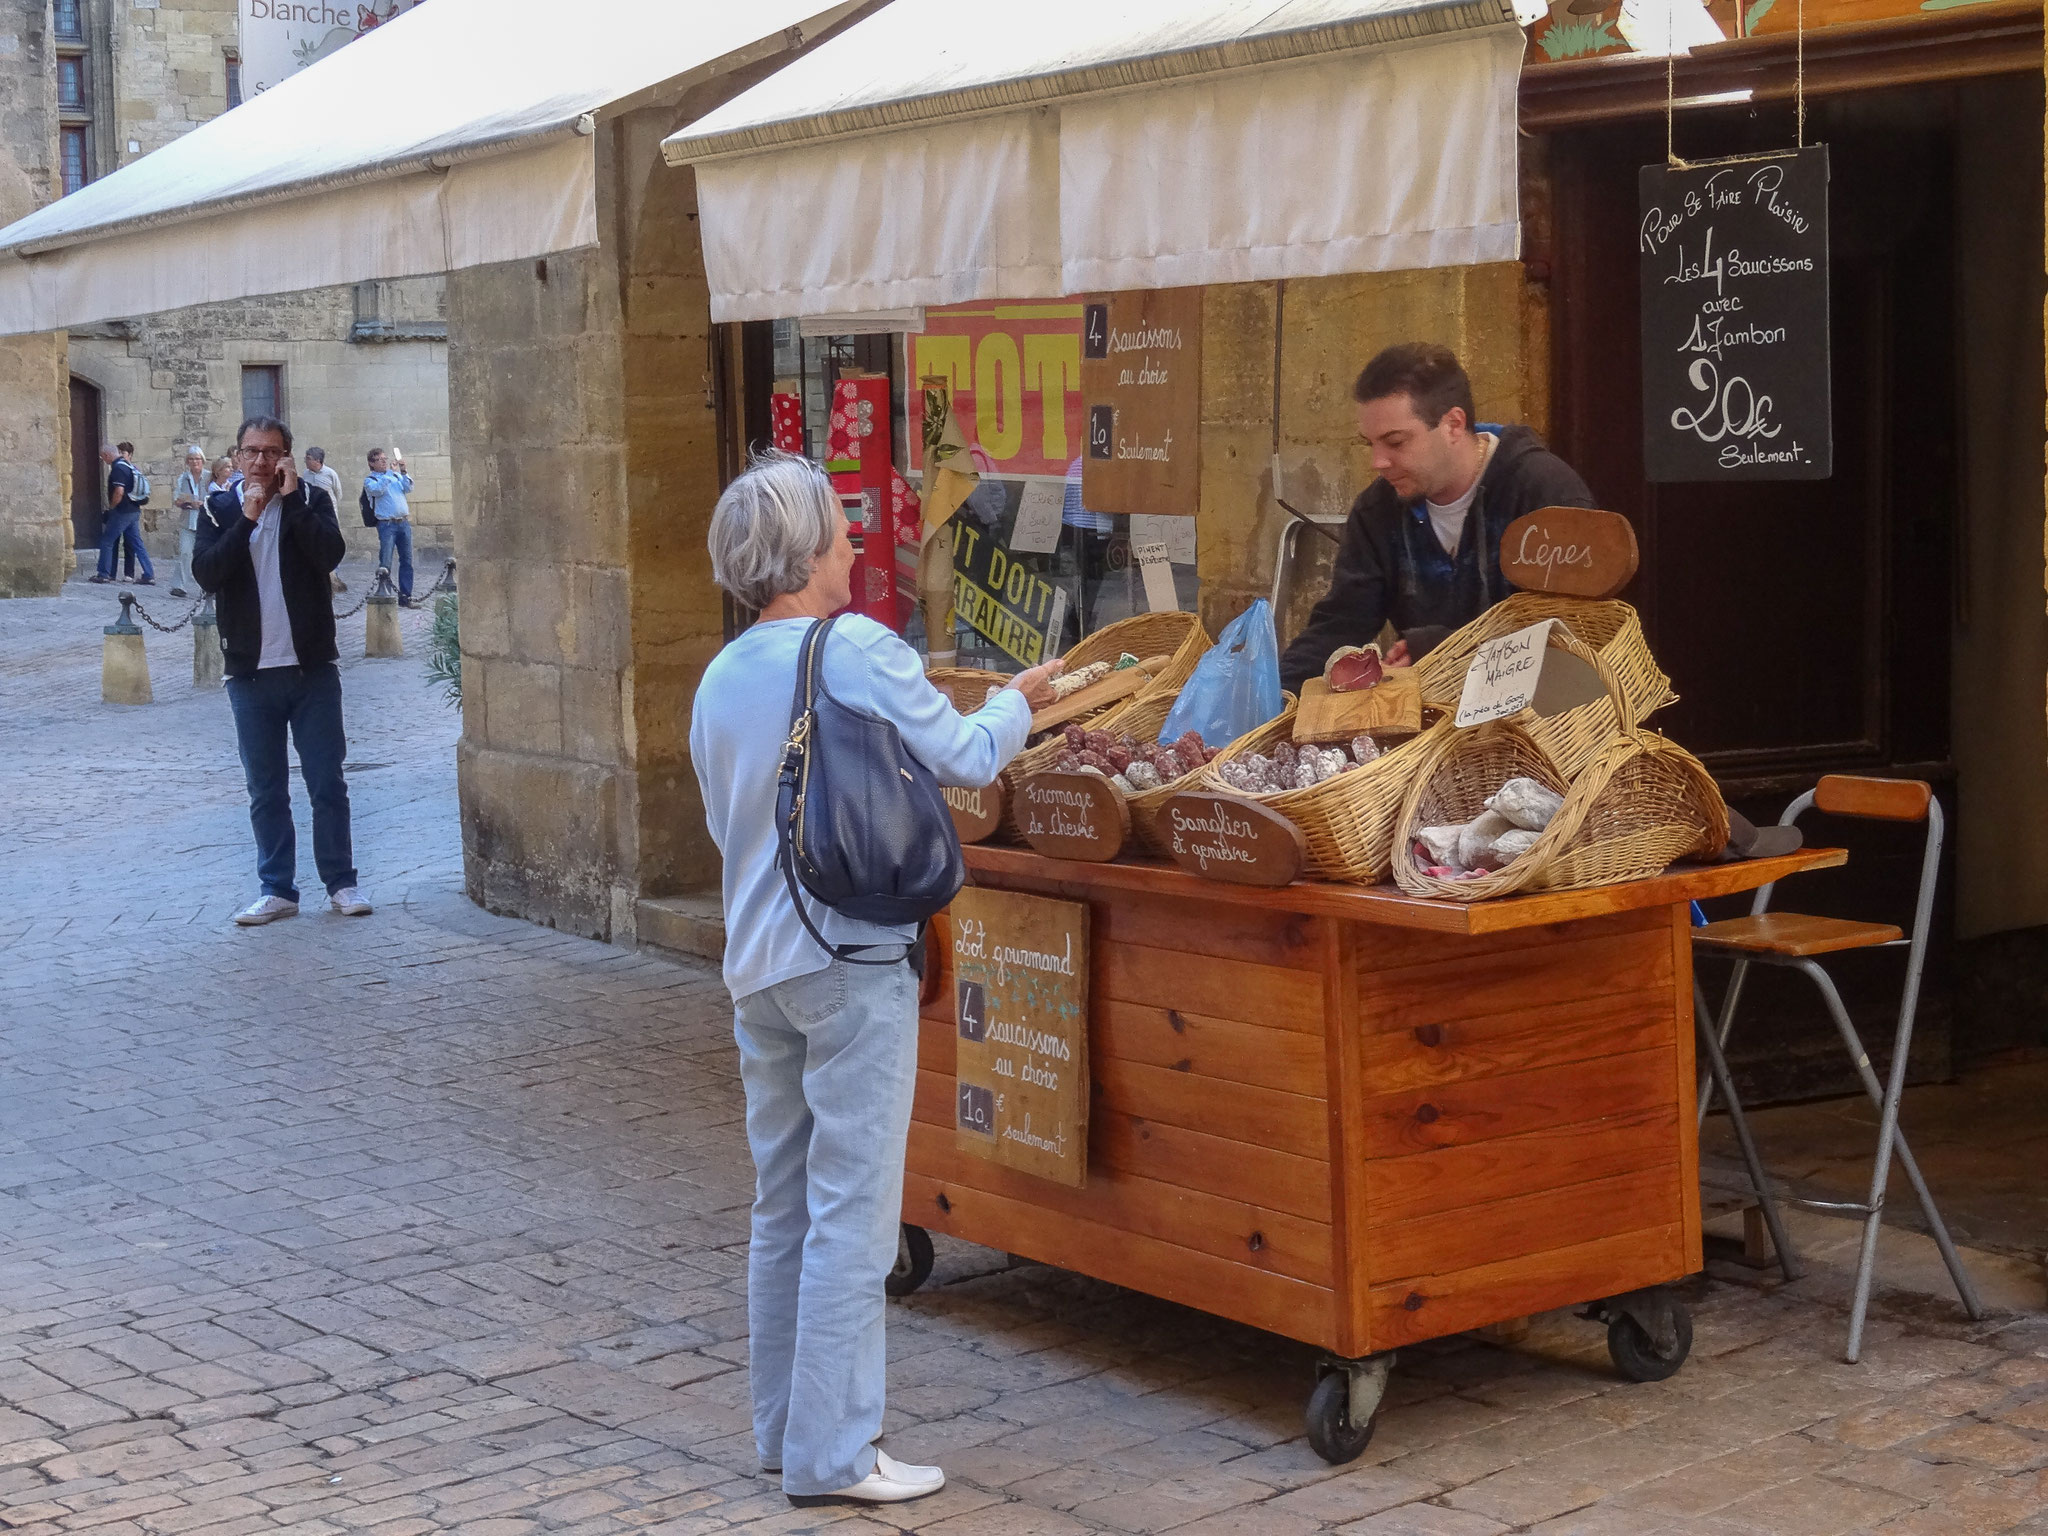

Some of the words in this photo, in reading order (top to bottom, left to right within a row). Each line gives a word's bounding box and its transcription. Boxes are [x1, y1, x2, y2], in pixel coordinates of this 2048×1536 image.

[1701, 226, 1723, 296] 4
[1727, 248, 1814, 277] Saucissons
[1702, 296, 1743, 314] avec
[1089, 311, 1102, 347] 4
[1106, 319, 1182, 353] saucissons
[1707, 315, 1786, 361] Jambon
[1118, 368, 1134, 386] au
[1137, 355, 1168, 385] choix
[1512, 524, 1593, 588] Cèpes
[988, 547, 1053, 623] DOIT
[1025, 782, 1095, 825] Fromage
[1027, 811, 1044, 835] de
[1049, 808, 1099, 840] Chèvre
[1171, 802, 1258, 843] Sanglier
[1172, 831, 1187, 854] et
[956, 918, 987, 959] Lot
[992, 932, 1075, 987] gourmand
[962, 987, 978, 1033] 4
[985, 1015, 1070, 1061] saucissons
[992, 1057, 1016, 1078] au
[1021, 1053, 1059, 1091] choix
[1002, 1112, 1067, 1158] seulement
